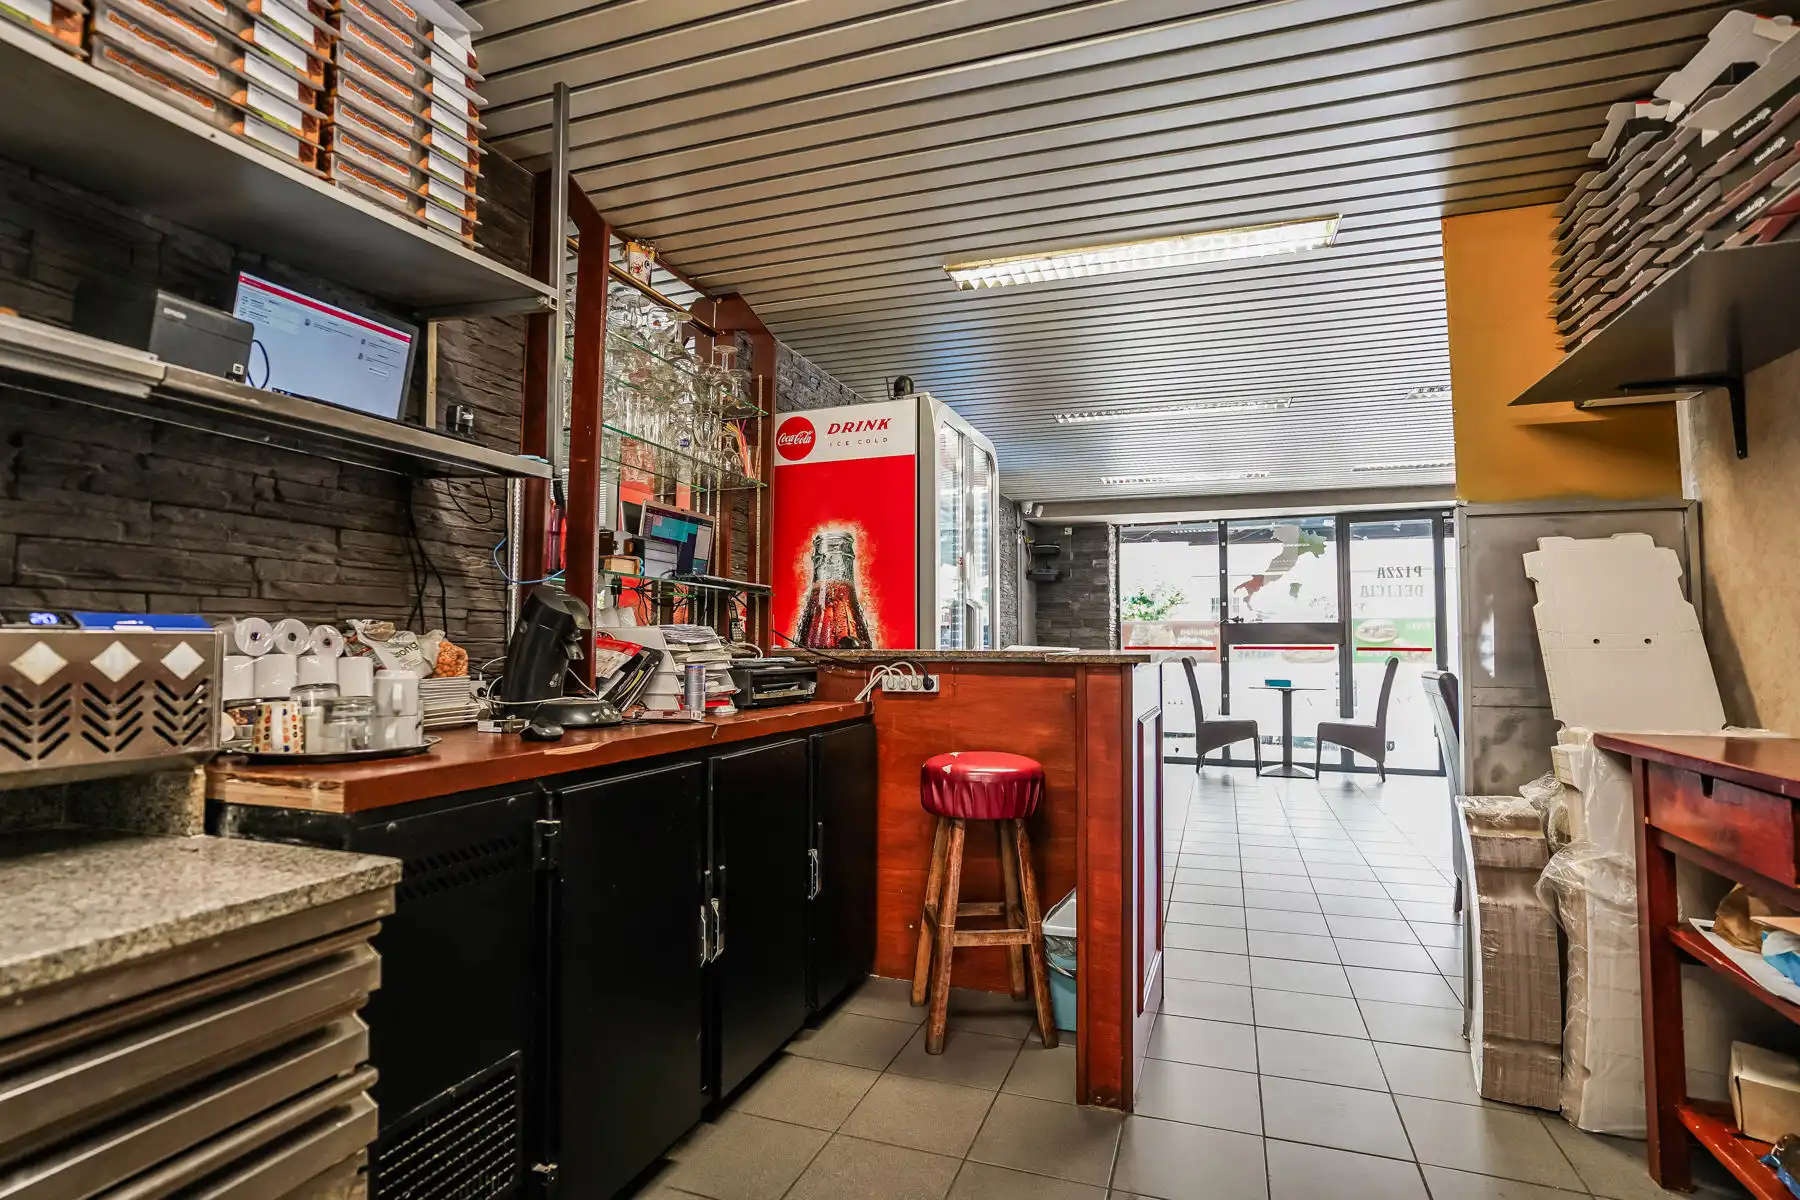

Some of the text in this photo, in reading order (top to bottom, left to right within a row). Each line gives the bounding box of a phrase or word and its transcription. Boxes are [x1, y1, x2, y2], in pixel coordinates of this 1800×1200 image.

[827, 418, 892, 435] DRINK
[778, 430, 813, 446] Coca-Cola
[857, 437, 888, 445] COLD
